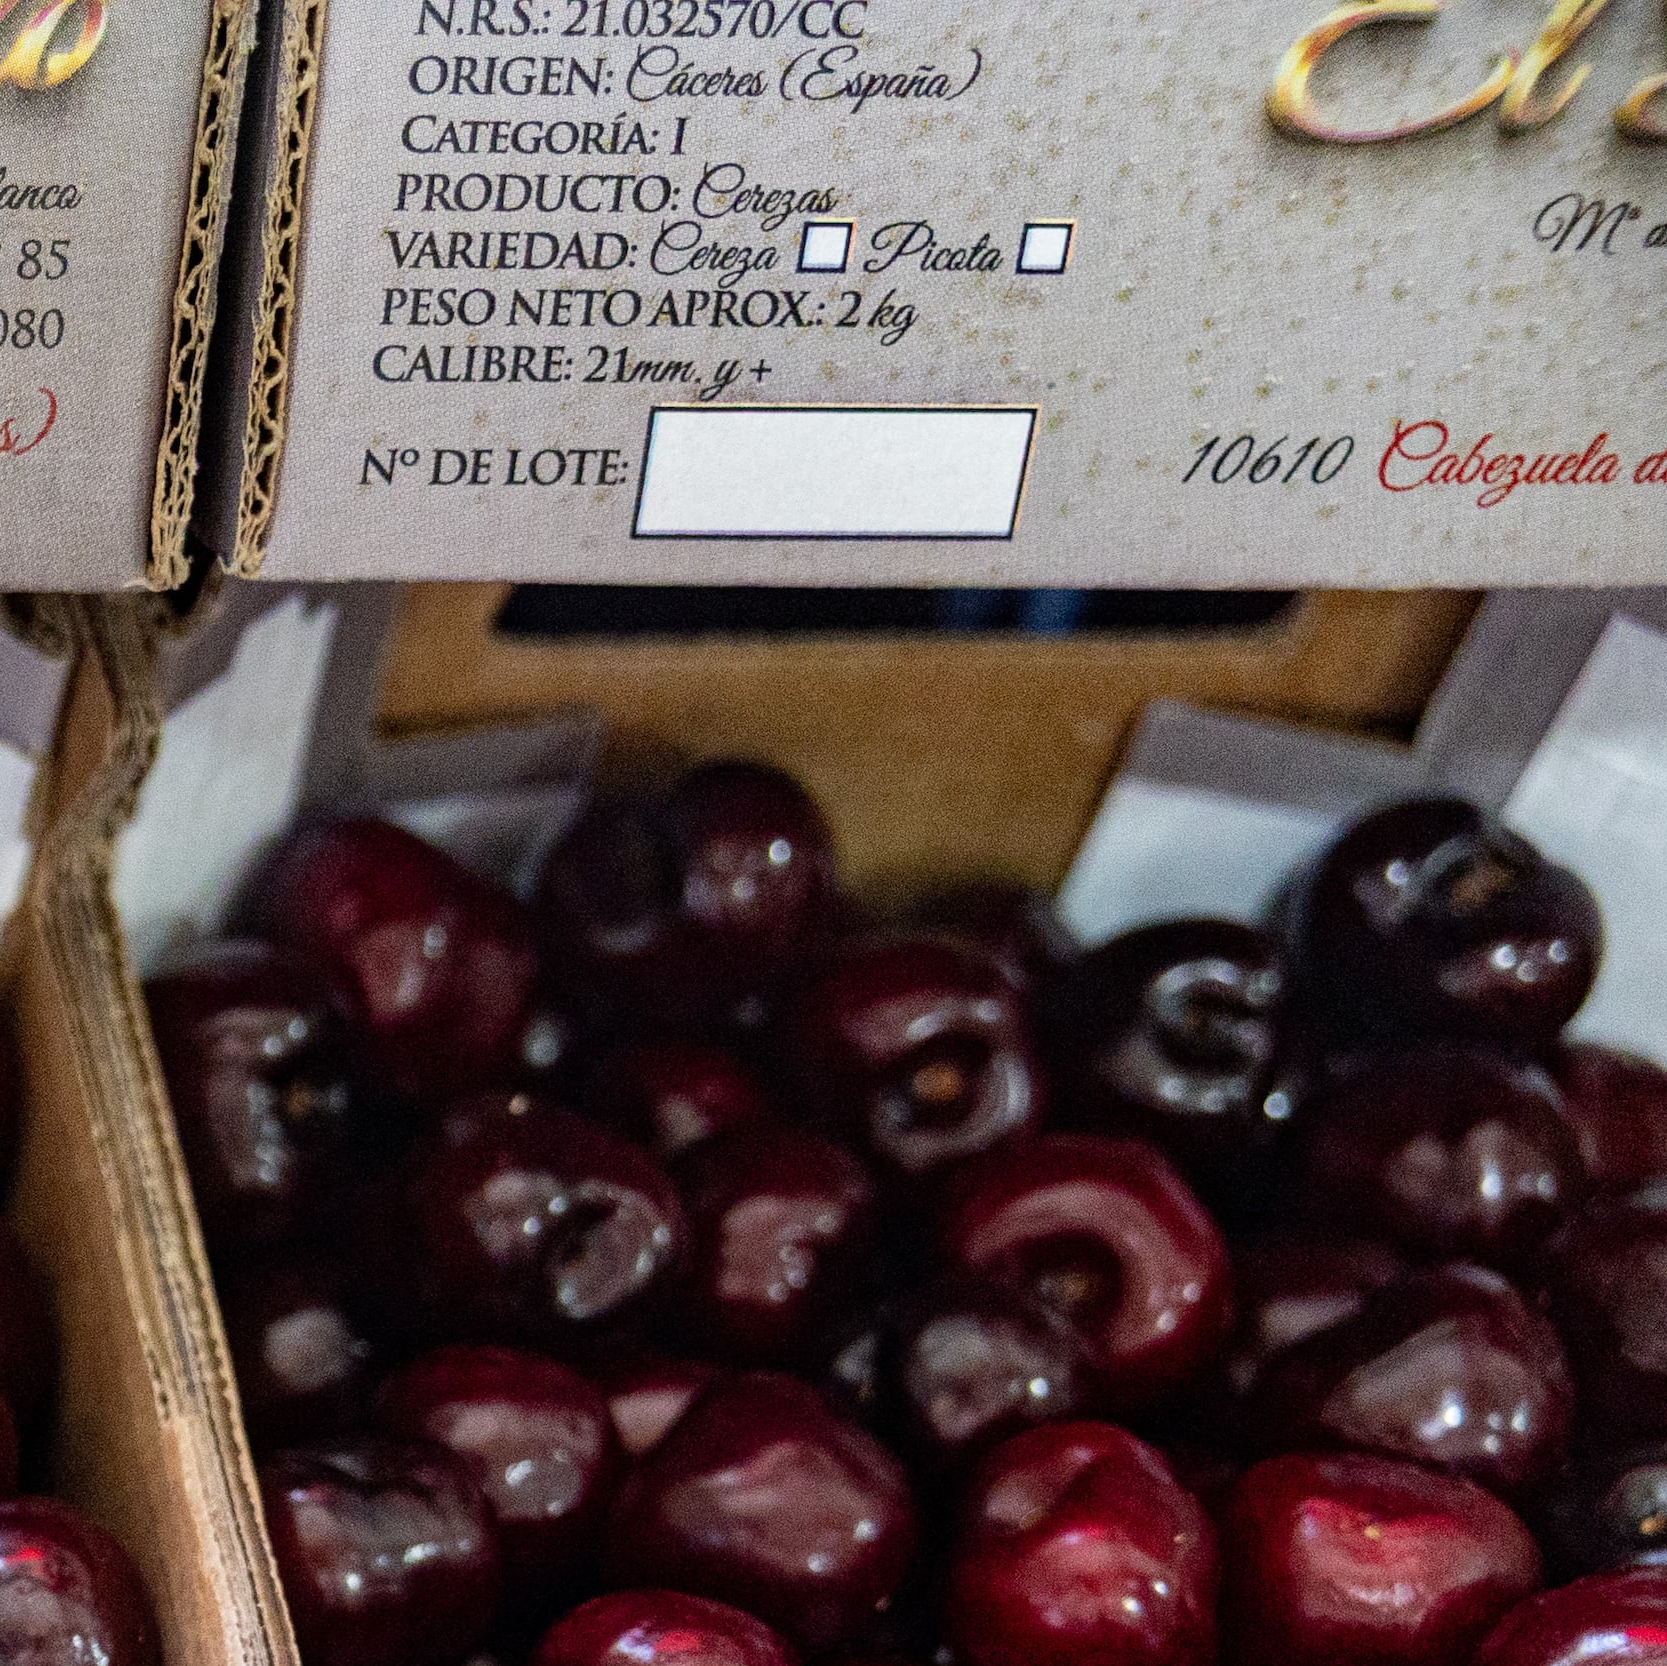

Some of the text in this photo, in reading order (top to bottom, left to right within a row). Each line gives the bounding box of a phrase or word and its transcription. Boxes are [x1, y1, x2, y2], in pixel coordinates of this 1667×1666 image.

[561, 0, 866, 39] 21.032570/CC
[408, 44, 983, 115] ORIGEN: Cáceres (España)
[671, 117, 687, 156] I
[394, 163, 838, 231] PRODUCTO: Cerezas
[16, 238, 71, 282] 85
[388, 219, 1004, 288] VARIEDAD: Cereza Picota
[381, 288, 496, 328] PESO
[507, 288, 641, 329] NETO
[645, 290, 827, 329] APROX.:
[371, 345, 575, 384] CALIBRE:
[432, 449, 492, 487] DE
[503, 450, 630, 487] LOTE:
[1181, 434, 1355, 486] 10610
[1378, 419, 1619, 509] Cabezuela
